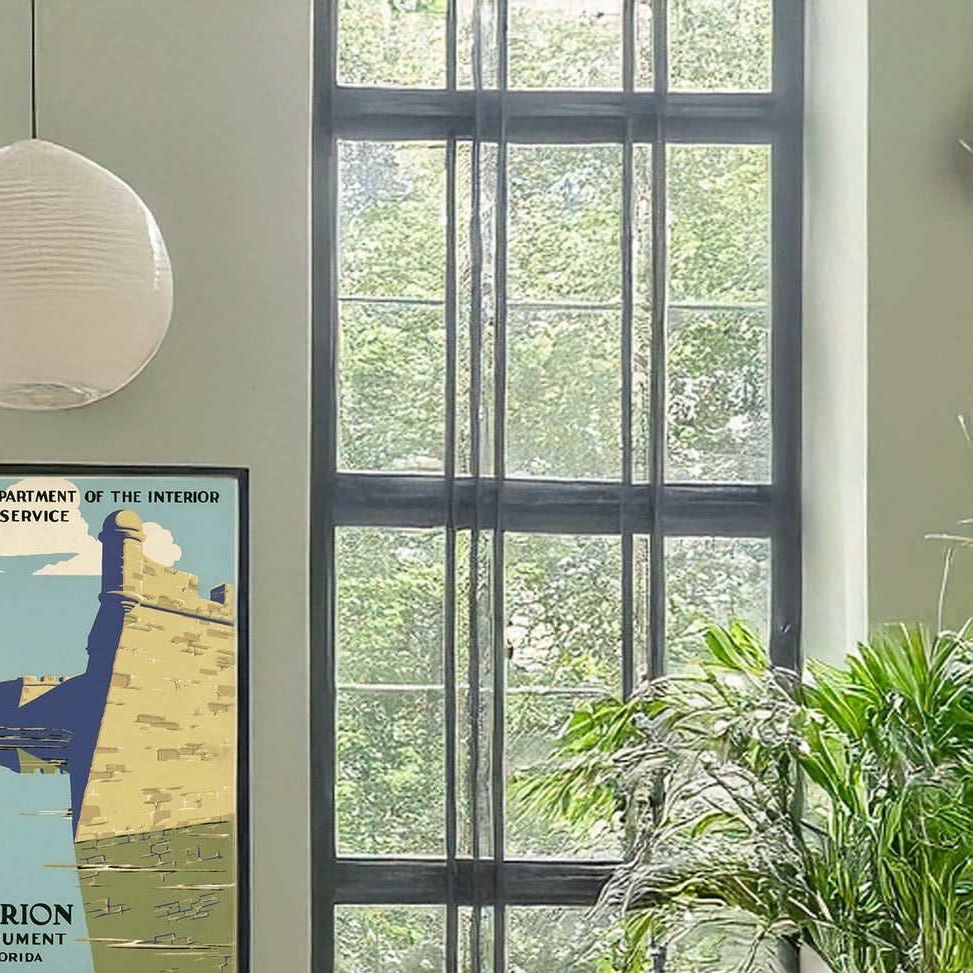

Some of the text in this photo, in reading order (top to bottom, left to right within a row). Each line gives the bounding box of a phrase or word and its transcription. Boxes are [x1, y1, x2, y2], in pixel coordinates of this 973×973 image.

[84, 490, 105, 504] OF
[110, 490, 142, 503] THE
[148, 490, 220, 504] INTERIOR
[0, 509, 70, 523] SERVICE
